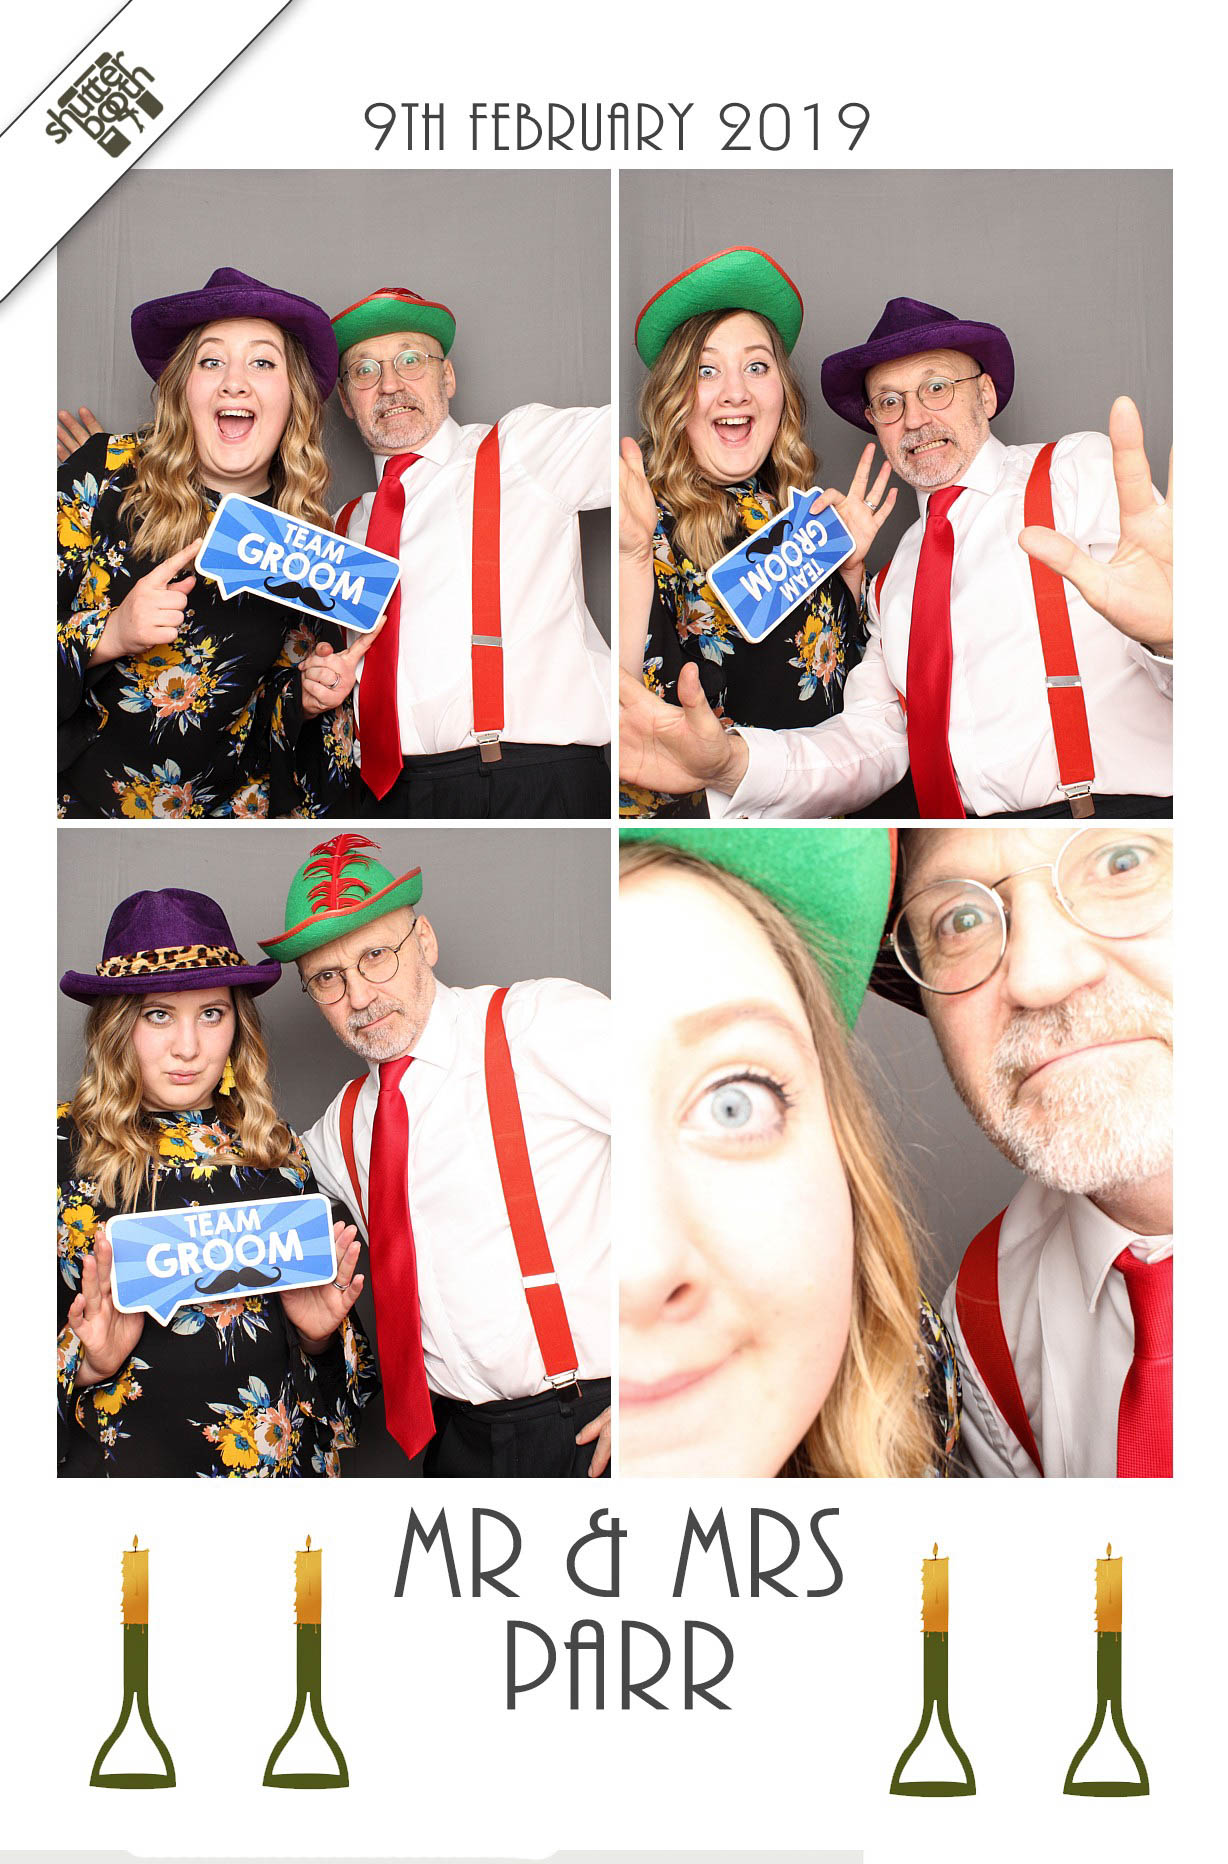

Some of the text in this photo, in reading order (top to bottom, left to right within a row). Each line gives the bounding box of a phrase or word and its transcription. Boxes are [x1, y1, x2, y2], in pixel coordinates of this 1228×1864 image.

[284, 522, 347, 564] TEAM
[739, 520, 828, 602] GROOM
[237, 532, 366, 605] GROOM
[779, 558, 825, 602] TEAM
[184, 1208, 262, 1238] TEAM
[146, 1229, 304, 1278] GROOM
